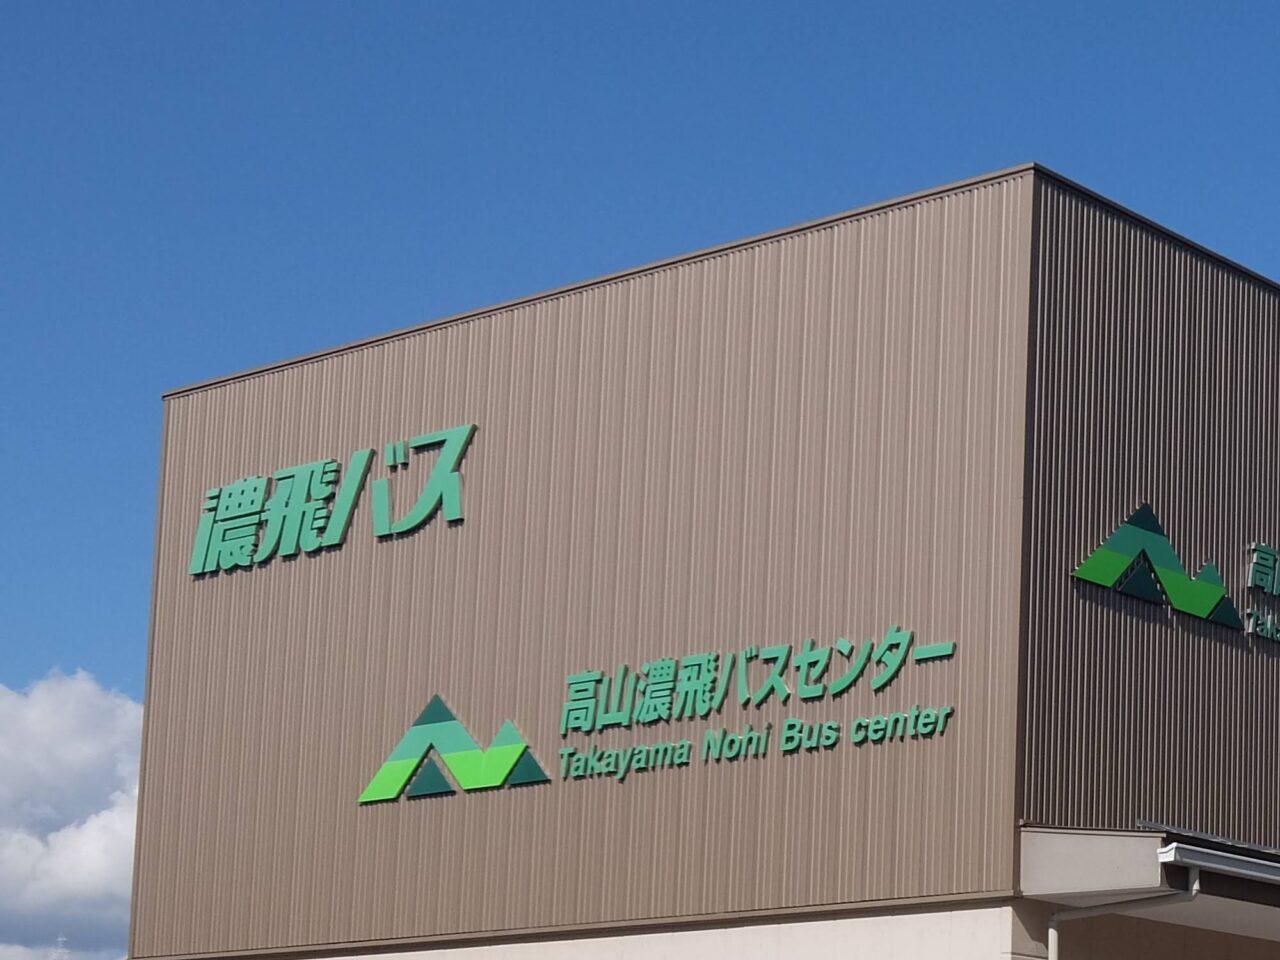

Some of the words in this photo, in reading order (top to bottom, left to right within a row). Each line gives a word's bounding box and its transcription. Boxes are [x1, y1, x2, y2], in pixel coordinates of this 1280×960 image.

[188, 424, 477, 576] 濃飛バス
[560, 626, 956, 735] 高山濃飛バスセンター
[558, 739, 692, 780] Takayama
[702, 721, 770, 760] Nohi
[779, 717, 840, 755] Bus
[850, 705, 954, 745] center
